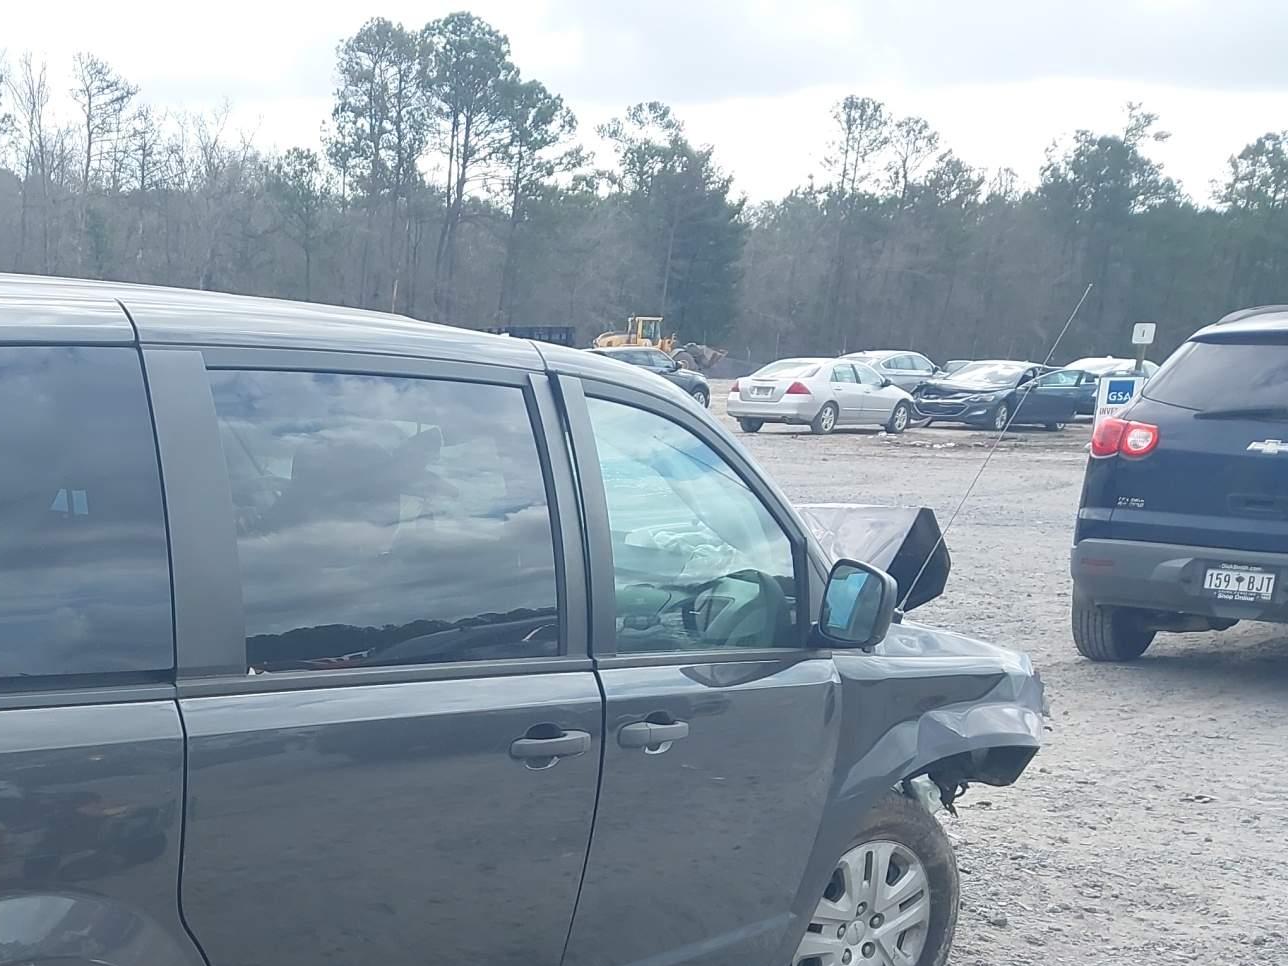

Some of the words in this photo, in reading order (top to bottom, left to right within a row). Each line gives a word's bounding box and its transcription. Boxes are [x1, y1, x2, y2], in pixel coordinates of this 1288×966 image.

[1109, 391, 1131, 401] GSA
[1209, 572, 1231, 589] 159
[1247, 575, 1272, 593] BJT
